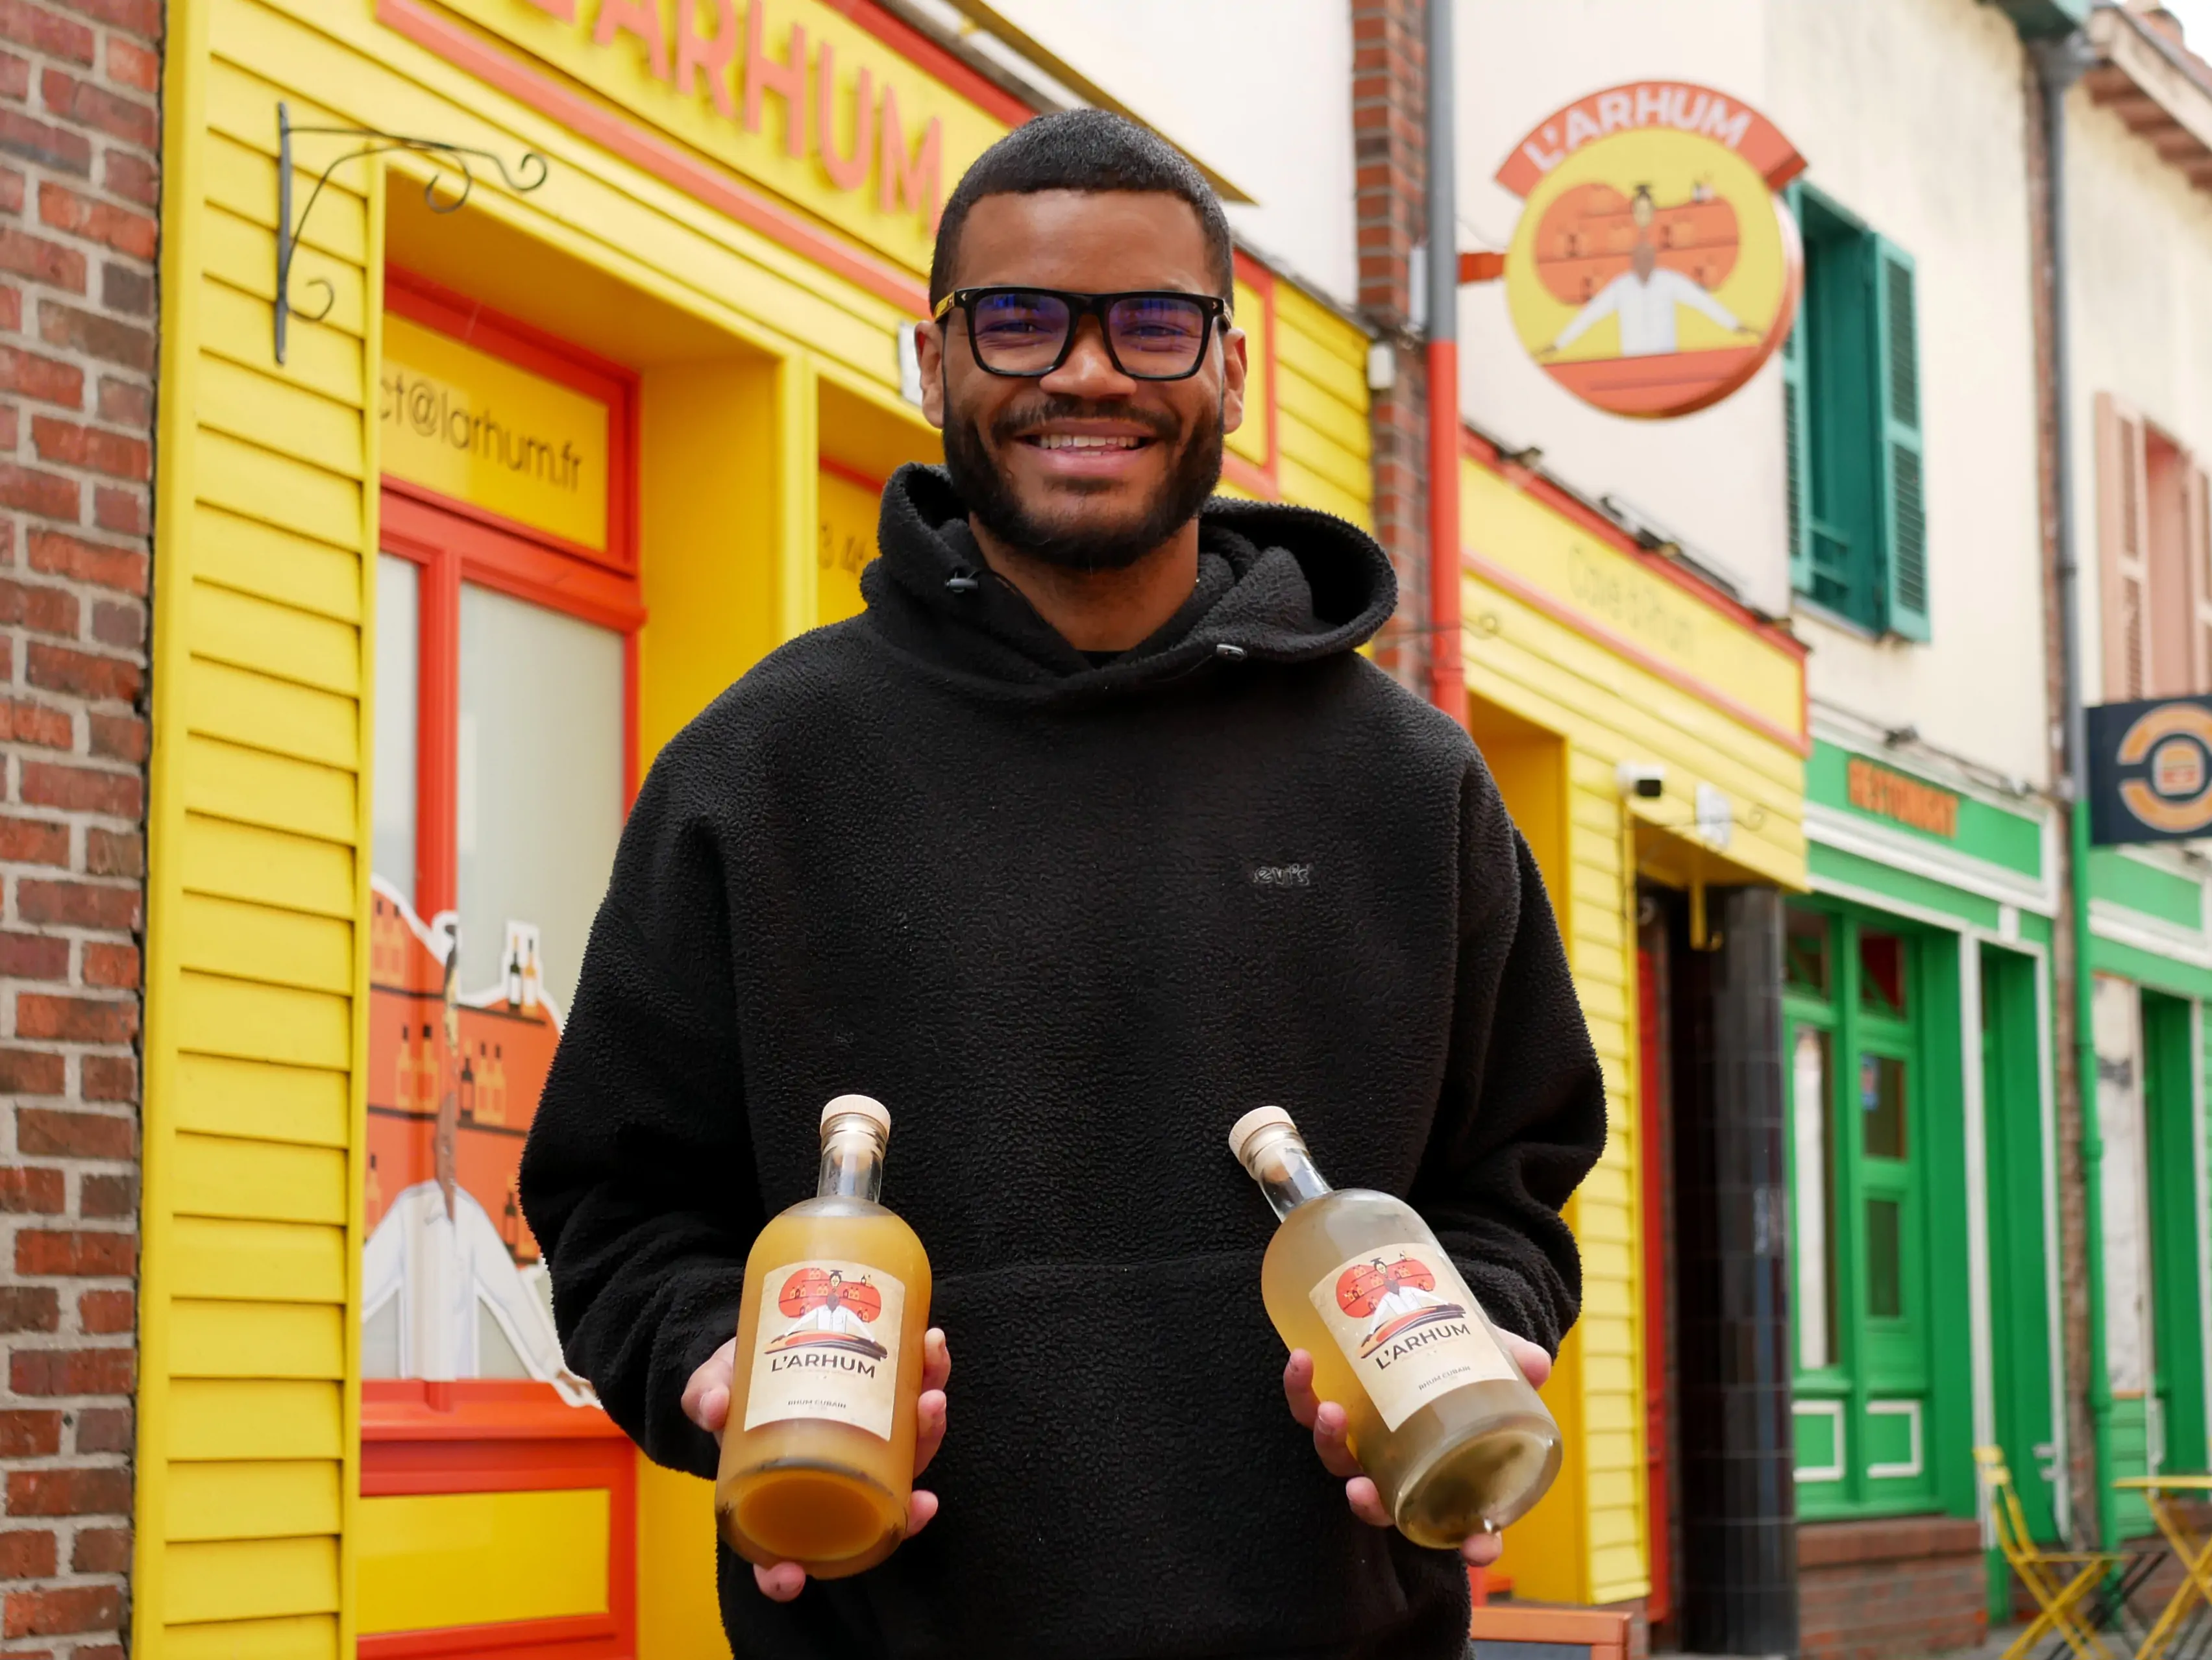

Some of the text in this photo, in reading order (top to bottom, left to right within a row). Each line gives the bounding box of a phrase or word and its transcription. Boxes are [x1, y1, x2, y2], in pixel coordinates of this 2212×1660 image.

[517, 0, 944, 238] ARHUM
[1522, 86, 1751, 172] L'ARHUM
[770, 1353, 876, 1379] L'ARHUM
[1375, 1324, 1471, 1370] L'ARHUM
[1418, 1375, 1442, 1391] RHUM
